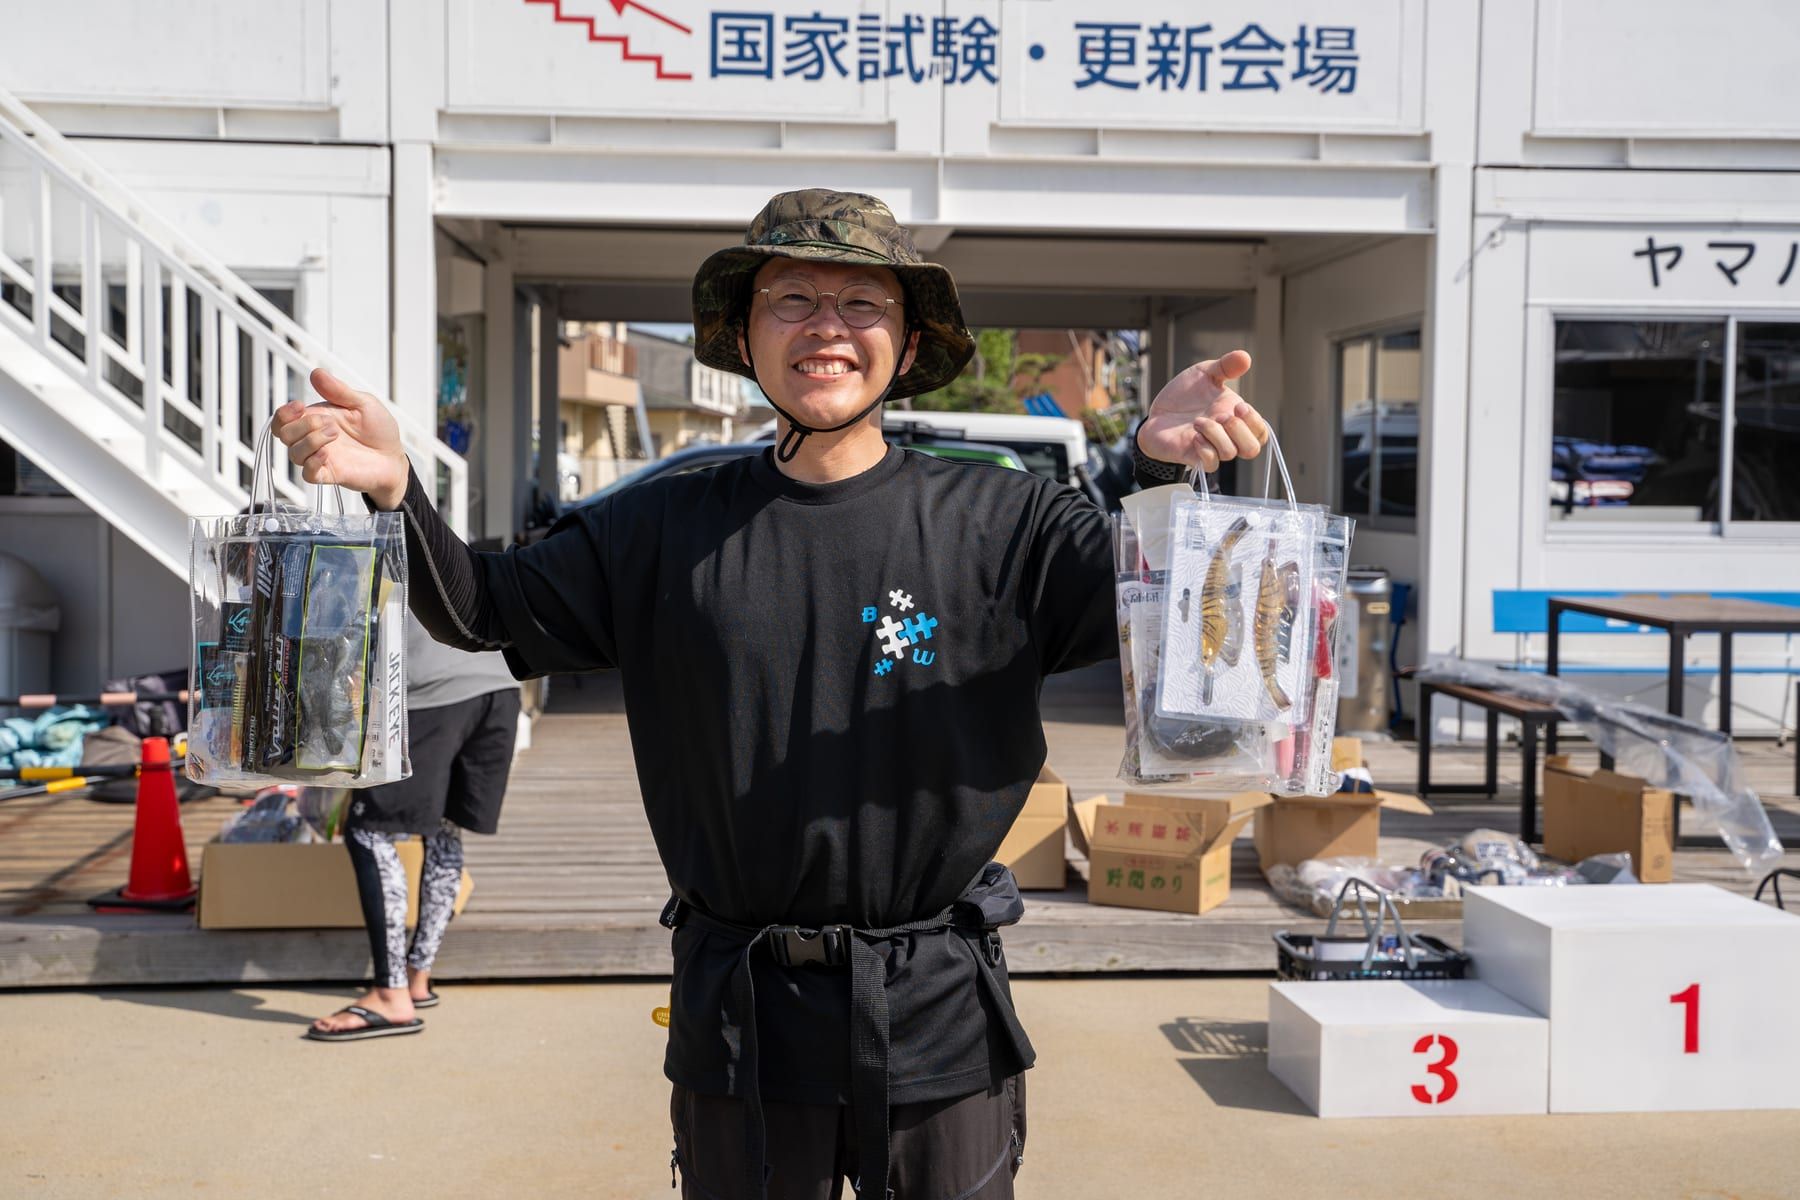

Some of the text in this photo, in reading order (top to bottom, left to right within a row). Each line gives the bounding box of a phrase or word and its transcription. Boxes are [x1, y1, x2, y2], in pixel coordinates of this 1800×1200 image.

[708, 10, 1360, 94] 国家試験・更新会場
[1670, 983, 1699, 1054] 1
[1411, 1034, 1459, 1104] 3
